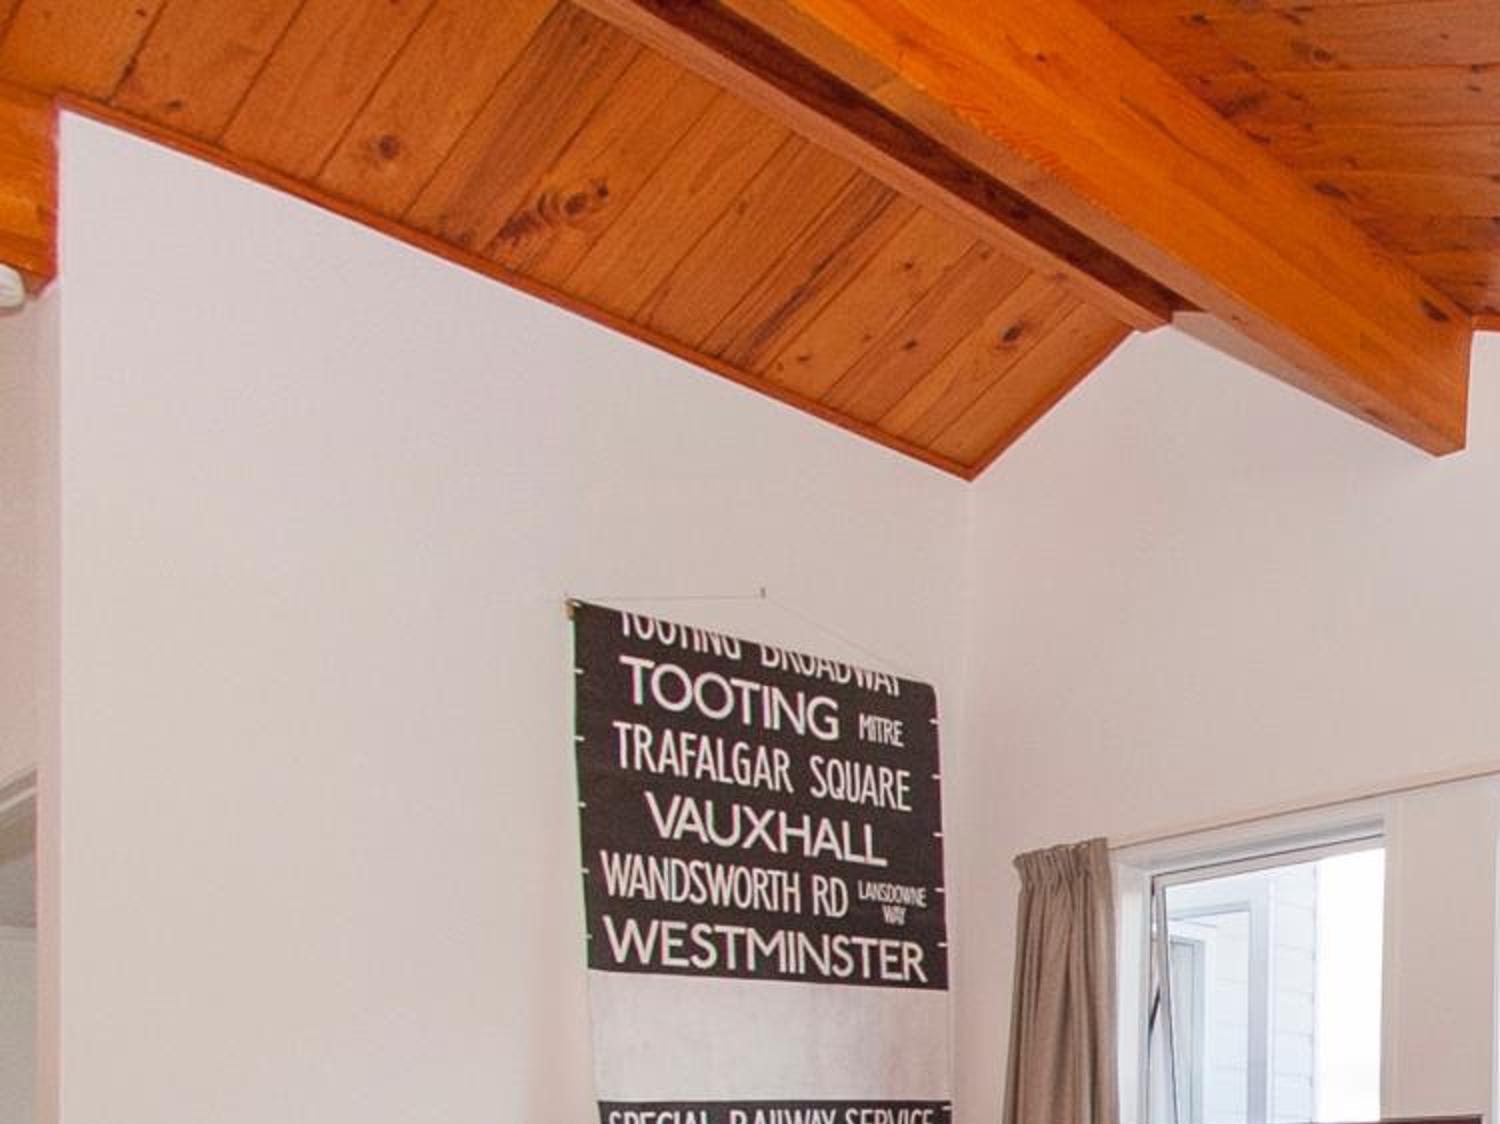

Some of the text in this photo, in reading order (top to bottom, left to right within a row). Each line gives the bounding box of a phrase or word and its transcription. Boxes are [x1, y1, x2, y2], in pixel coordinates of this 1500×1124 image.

[619, 655, 904, 748] TOOTING MITRE
[613, 721, 912, 812] TRAFALGAR SQUARE
[644, 791, 888, 867] VAUXHALL
[600, 849, 849, 918] WANDSWORTH RD
[602, 915, 928, 983] WESTMINSTER
